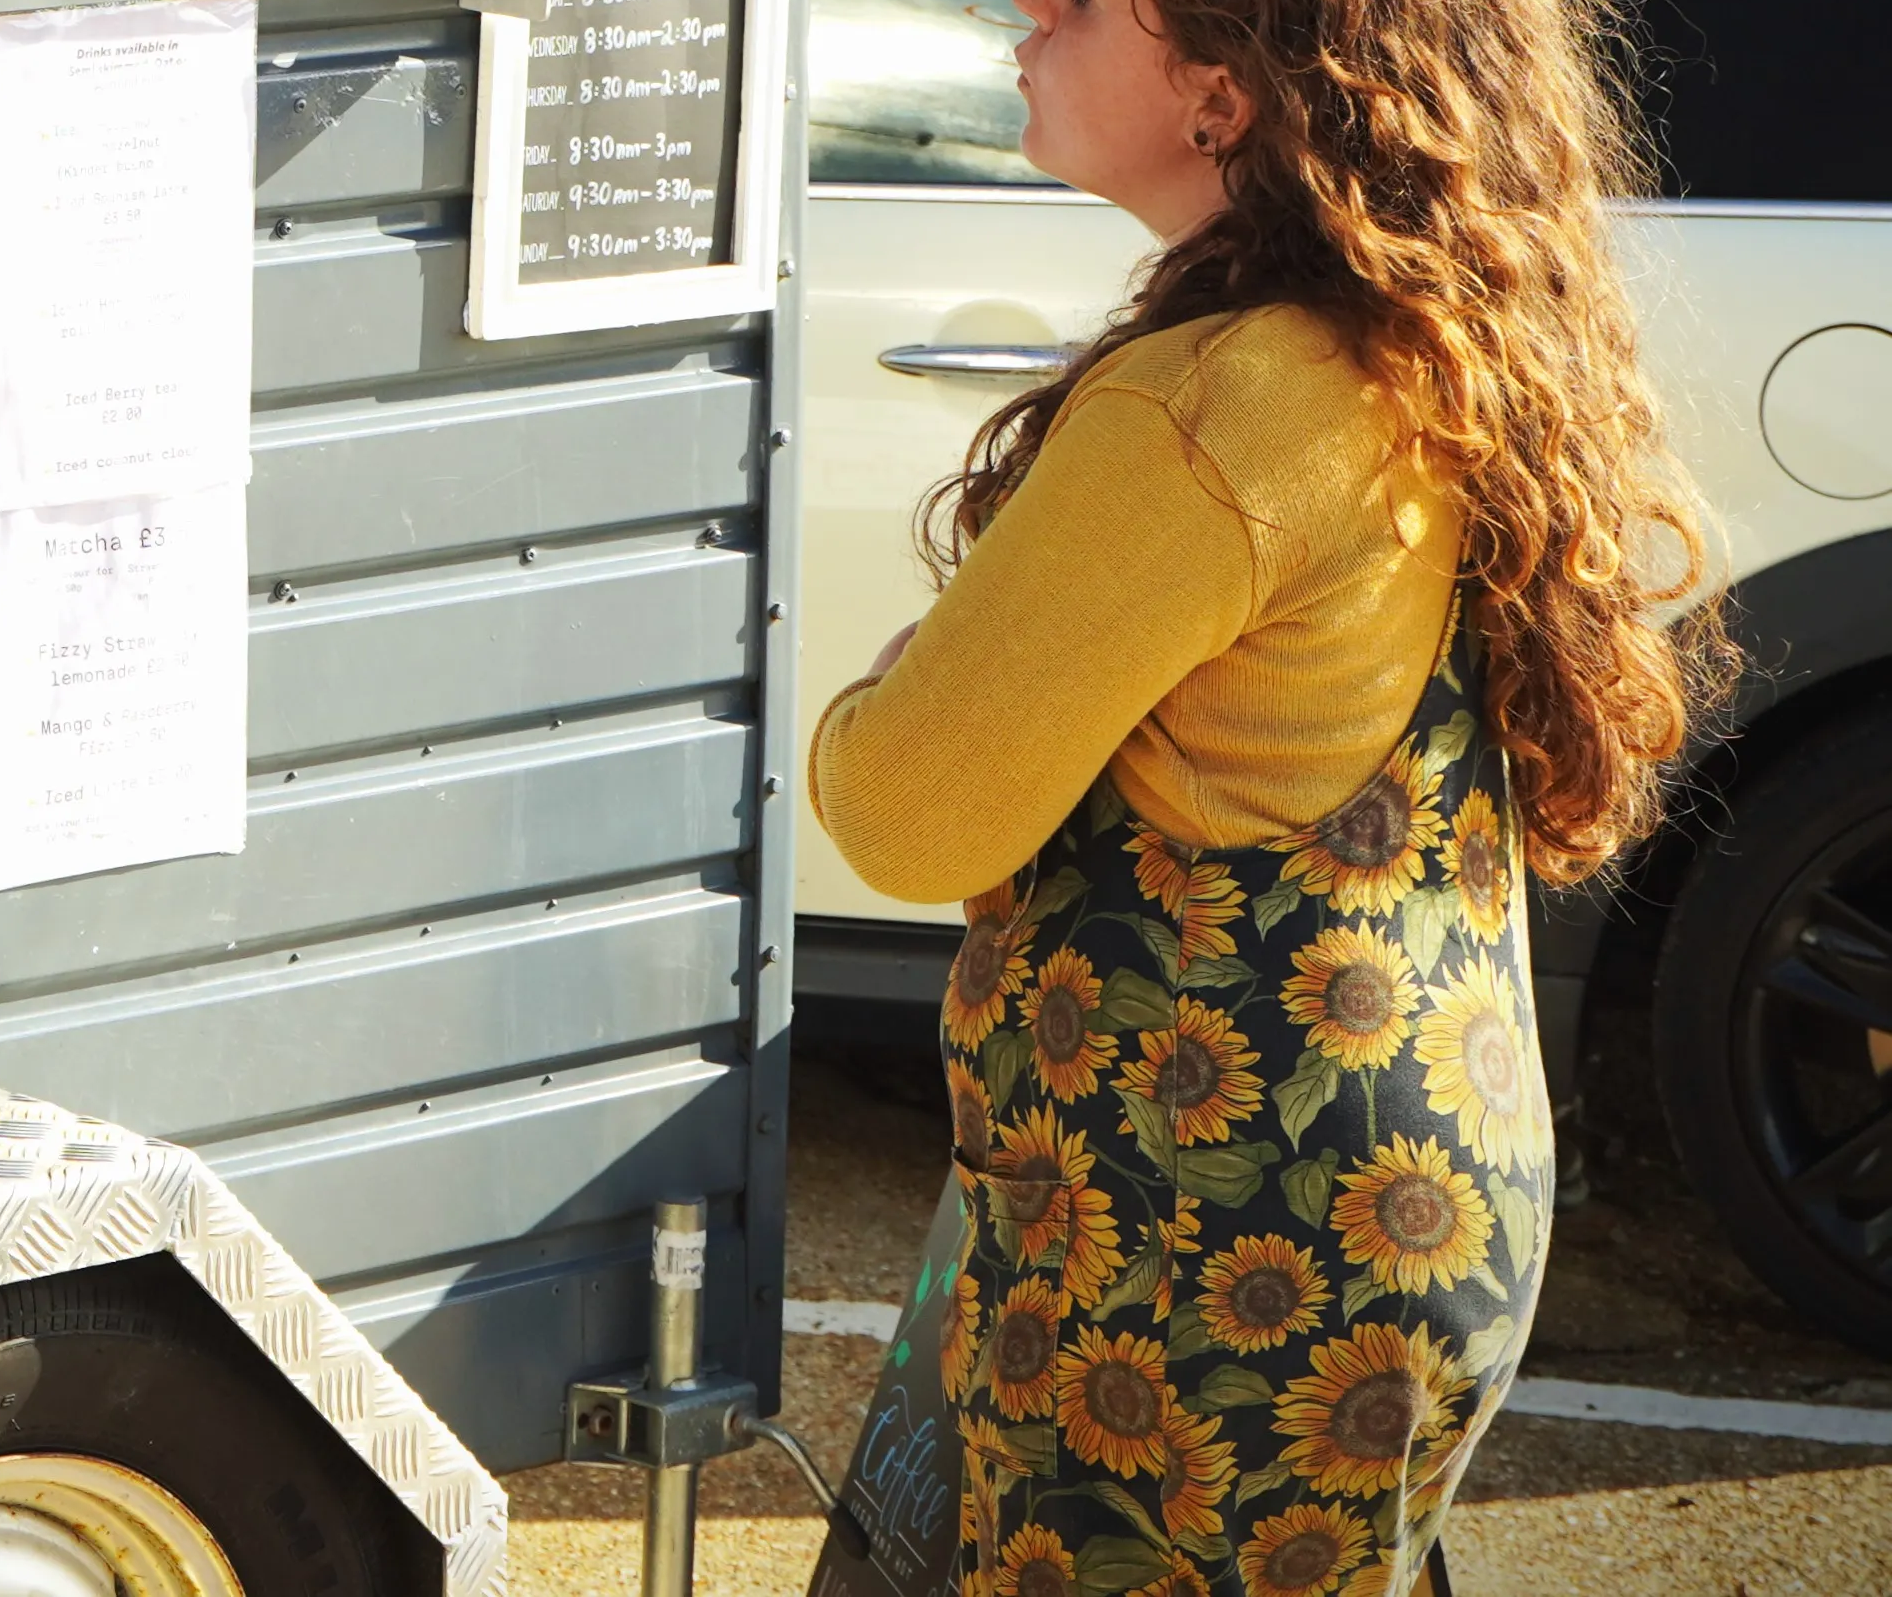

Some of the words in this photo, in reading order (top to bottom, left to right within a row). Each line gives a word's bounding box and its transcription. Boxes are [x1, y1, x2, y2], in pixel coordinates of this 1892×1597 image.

[76, 46, 113, 60] Drinks
[115, 39, 167, 57] available
[168, 39, 179, 51] in
[65, 391, 98, 407] Iced
[105, 384, 146, 404] Berry
[45, 532, 124, 560] Matcha
[40, 717, 94, 737] Mango
